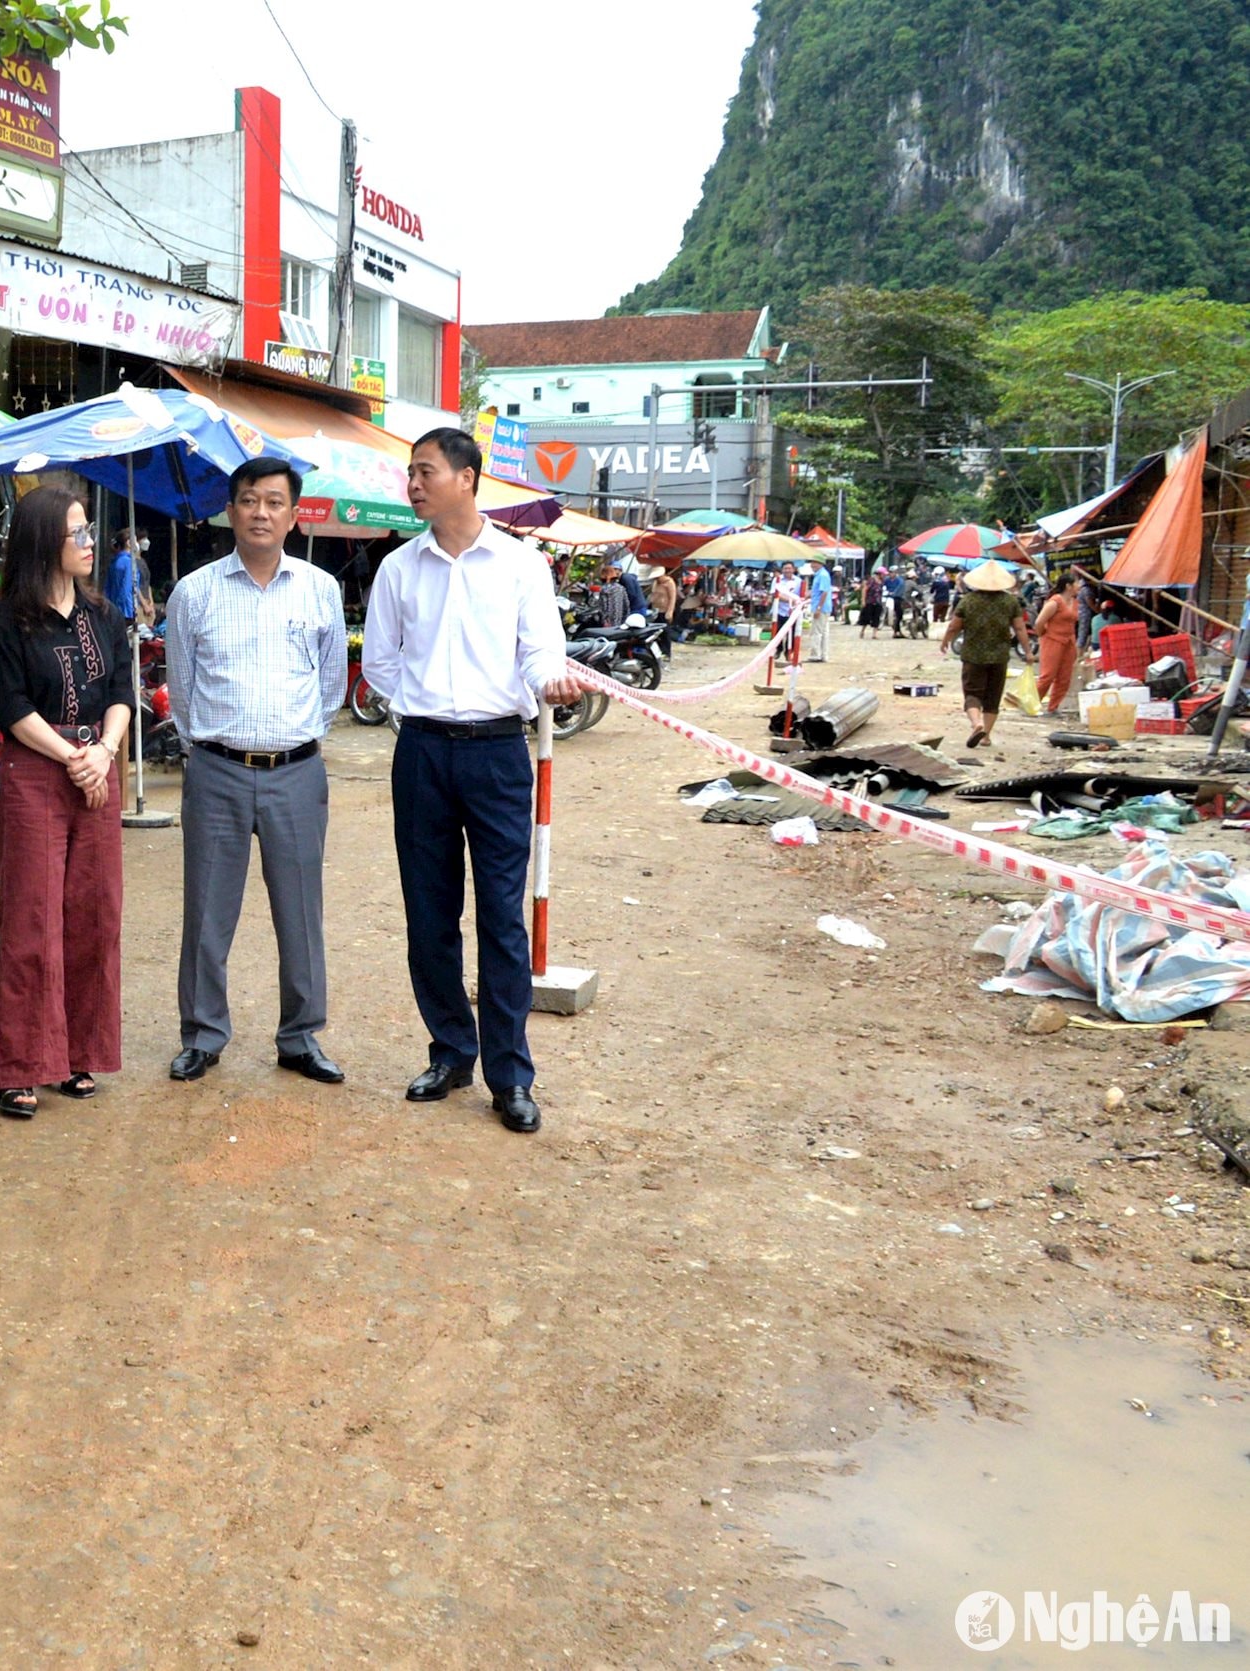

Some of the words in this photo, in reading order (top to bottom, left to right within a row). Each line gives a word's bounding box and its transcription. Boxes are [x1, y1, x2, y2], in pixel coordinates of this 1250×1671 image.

[361, 185, 424, 242] HONDA
[5, 251, 64, 279] THỜI
[77, 269, 154, 301] TRANG
[165, 291, 204, 314] TÓC
[38, 284, 88, 325] UỐN
[113, 299, 135, 334] ÉP
[588, 445, 710, 474] YADEA
